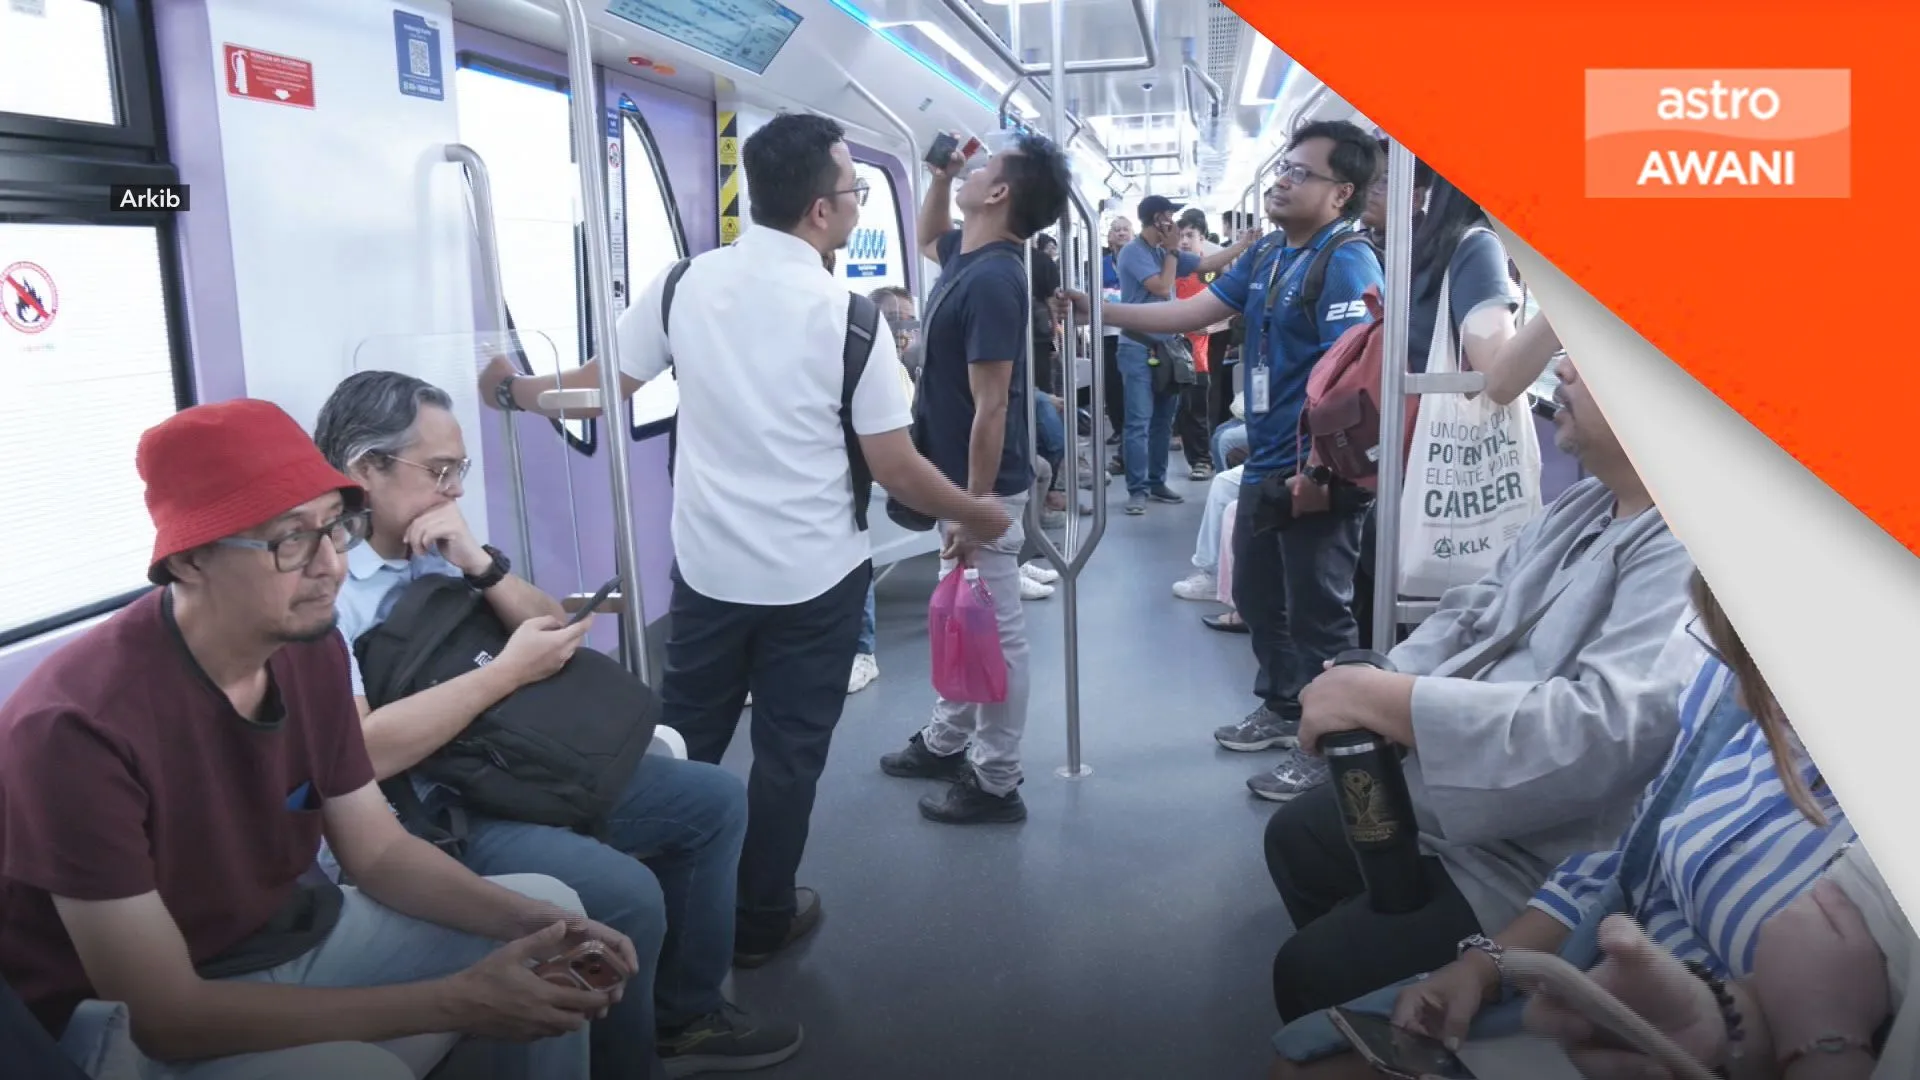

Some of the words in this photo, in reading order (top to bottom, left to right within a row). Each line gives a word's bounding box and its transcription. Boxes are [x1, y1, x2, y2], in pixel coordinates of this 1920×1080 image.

[1325, 299, 1367, 321] 25
[1430, 421, 1487, 442] UNLOC
[1424, 471, 1523, 518] CAREER
[1459, 536, 1492, 555] KLK
